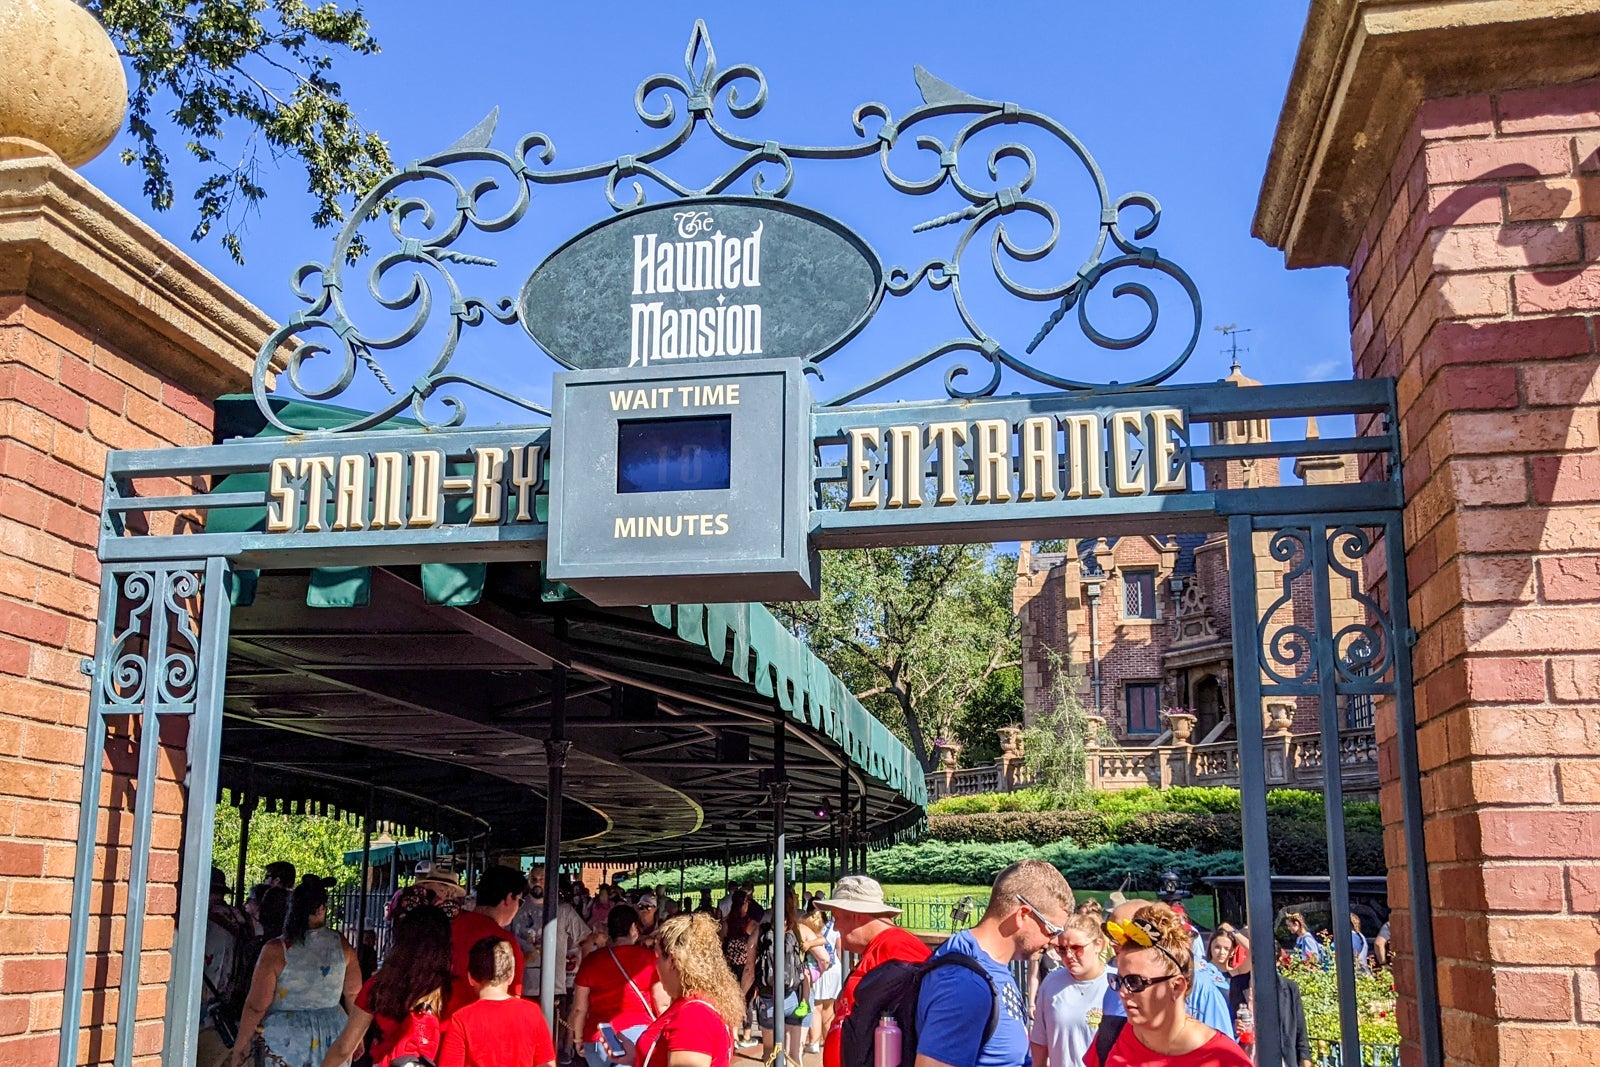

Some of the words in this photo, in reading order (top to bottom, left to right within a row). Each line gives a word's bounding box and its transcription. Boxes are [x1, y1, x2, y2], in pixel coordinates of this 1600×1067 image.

[631, 219, 764, 295] Haunted
[673, 211, 714, 238] The
[627, 293, 763, 368] Mansion
[609, 388, 674, 411] WAIT
[678, 383, 740, 407] TIME
[267, 446, 541, 532] STAND-BY
[848, 407, 1186, 508] ENTRANCE
[613, 513, 729, 539] MINUTES
